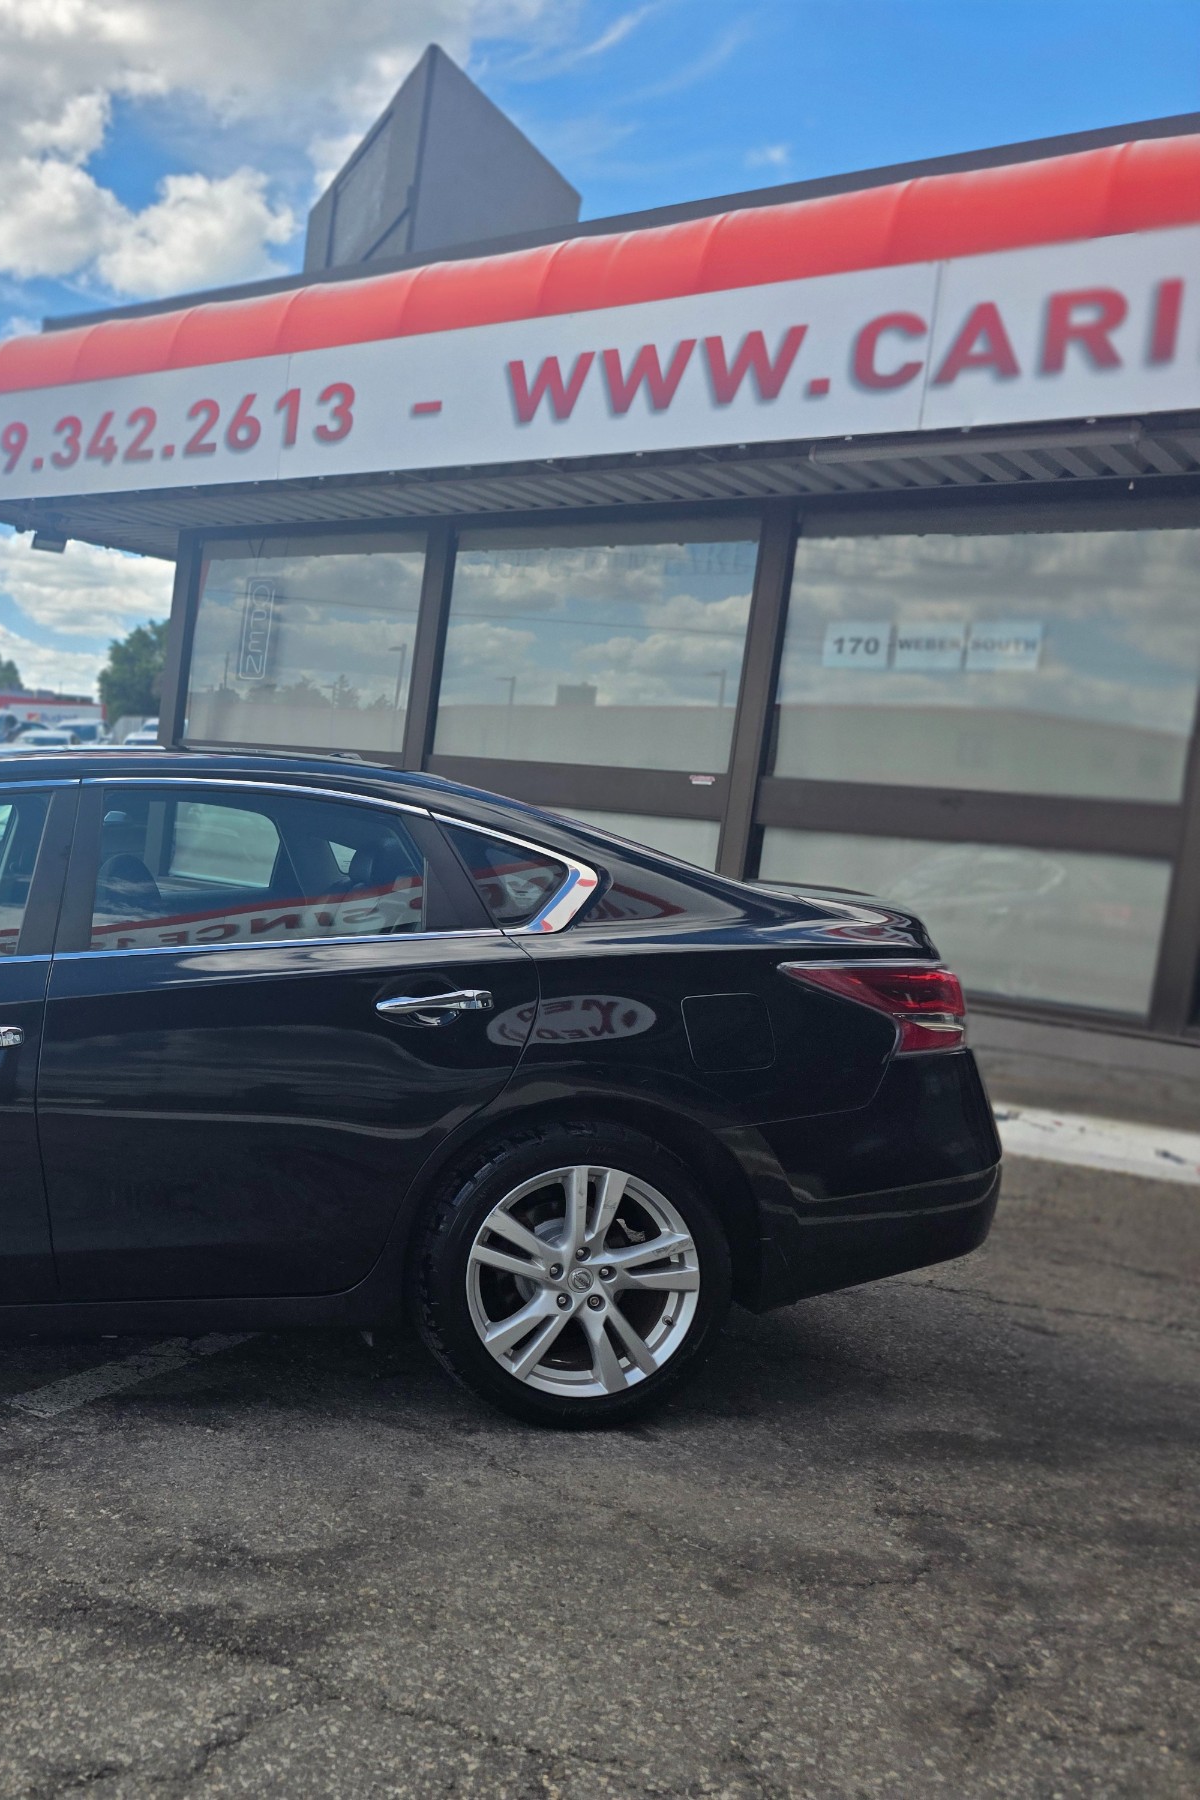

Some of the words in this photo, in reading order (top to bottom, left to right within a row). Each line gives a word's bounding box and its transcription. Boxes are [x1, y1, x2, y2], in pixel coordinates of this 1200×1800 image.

[506, 278, 1185, 424] WWW.CARI
[246, 585, 272, 674] OPEN
[833, 637, 881, 654] 170
